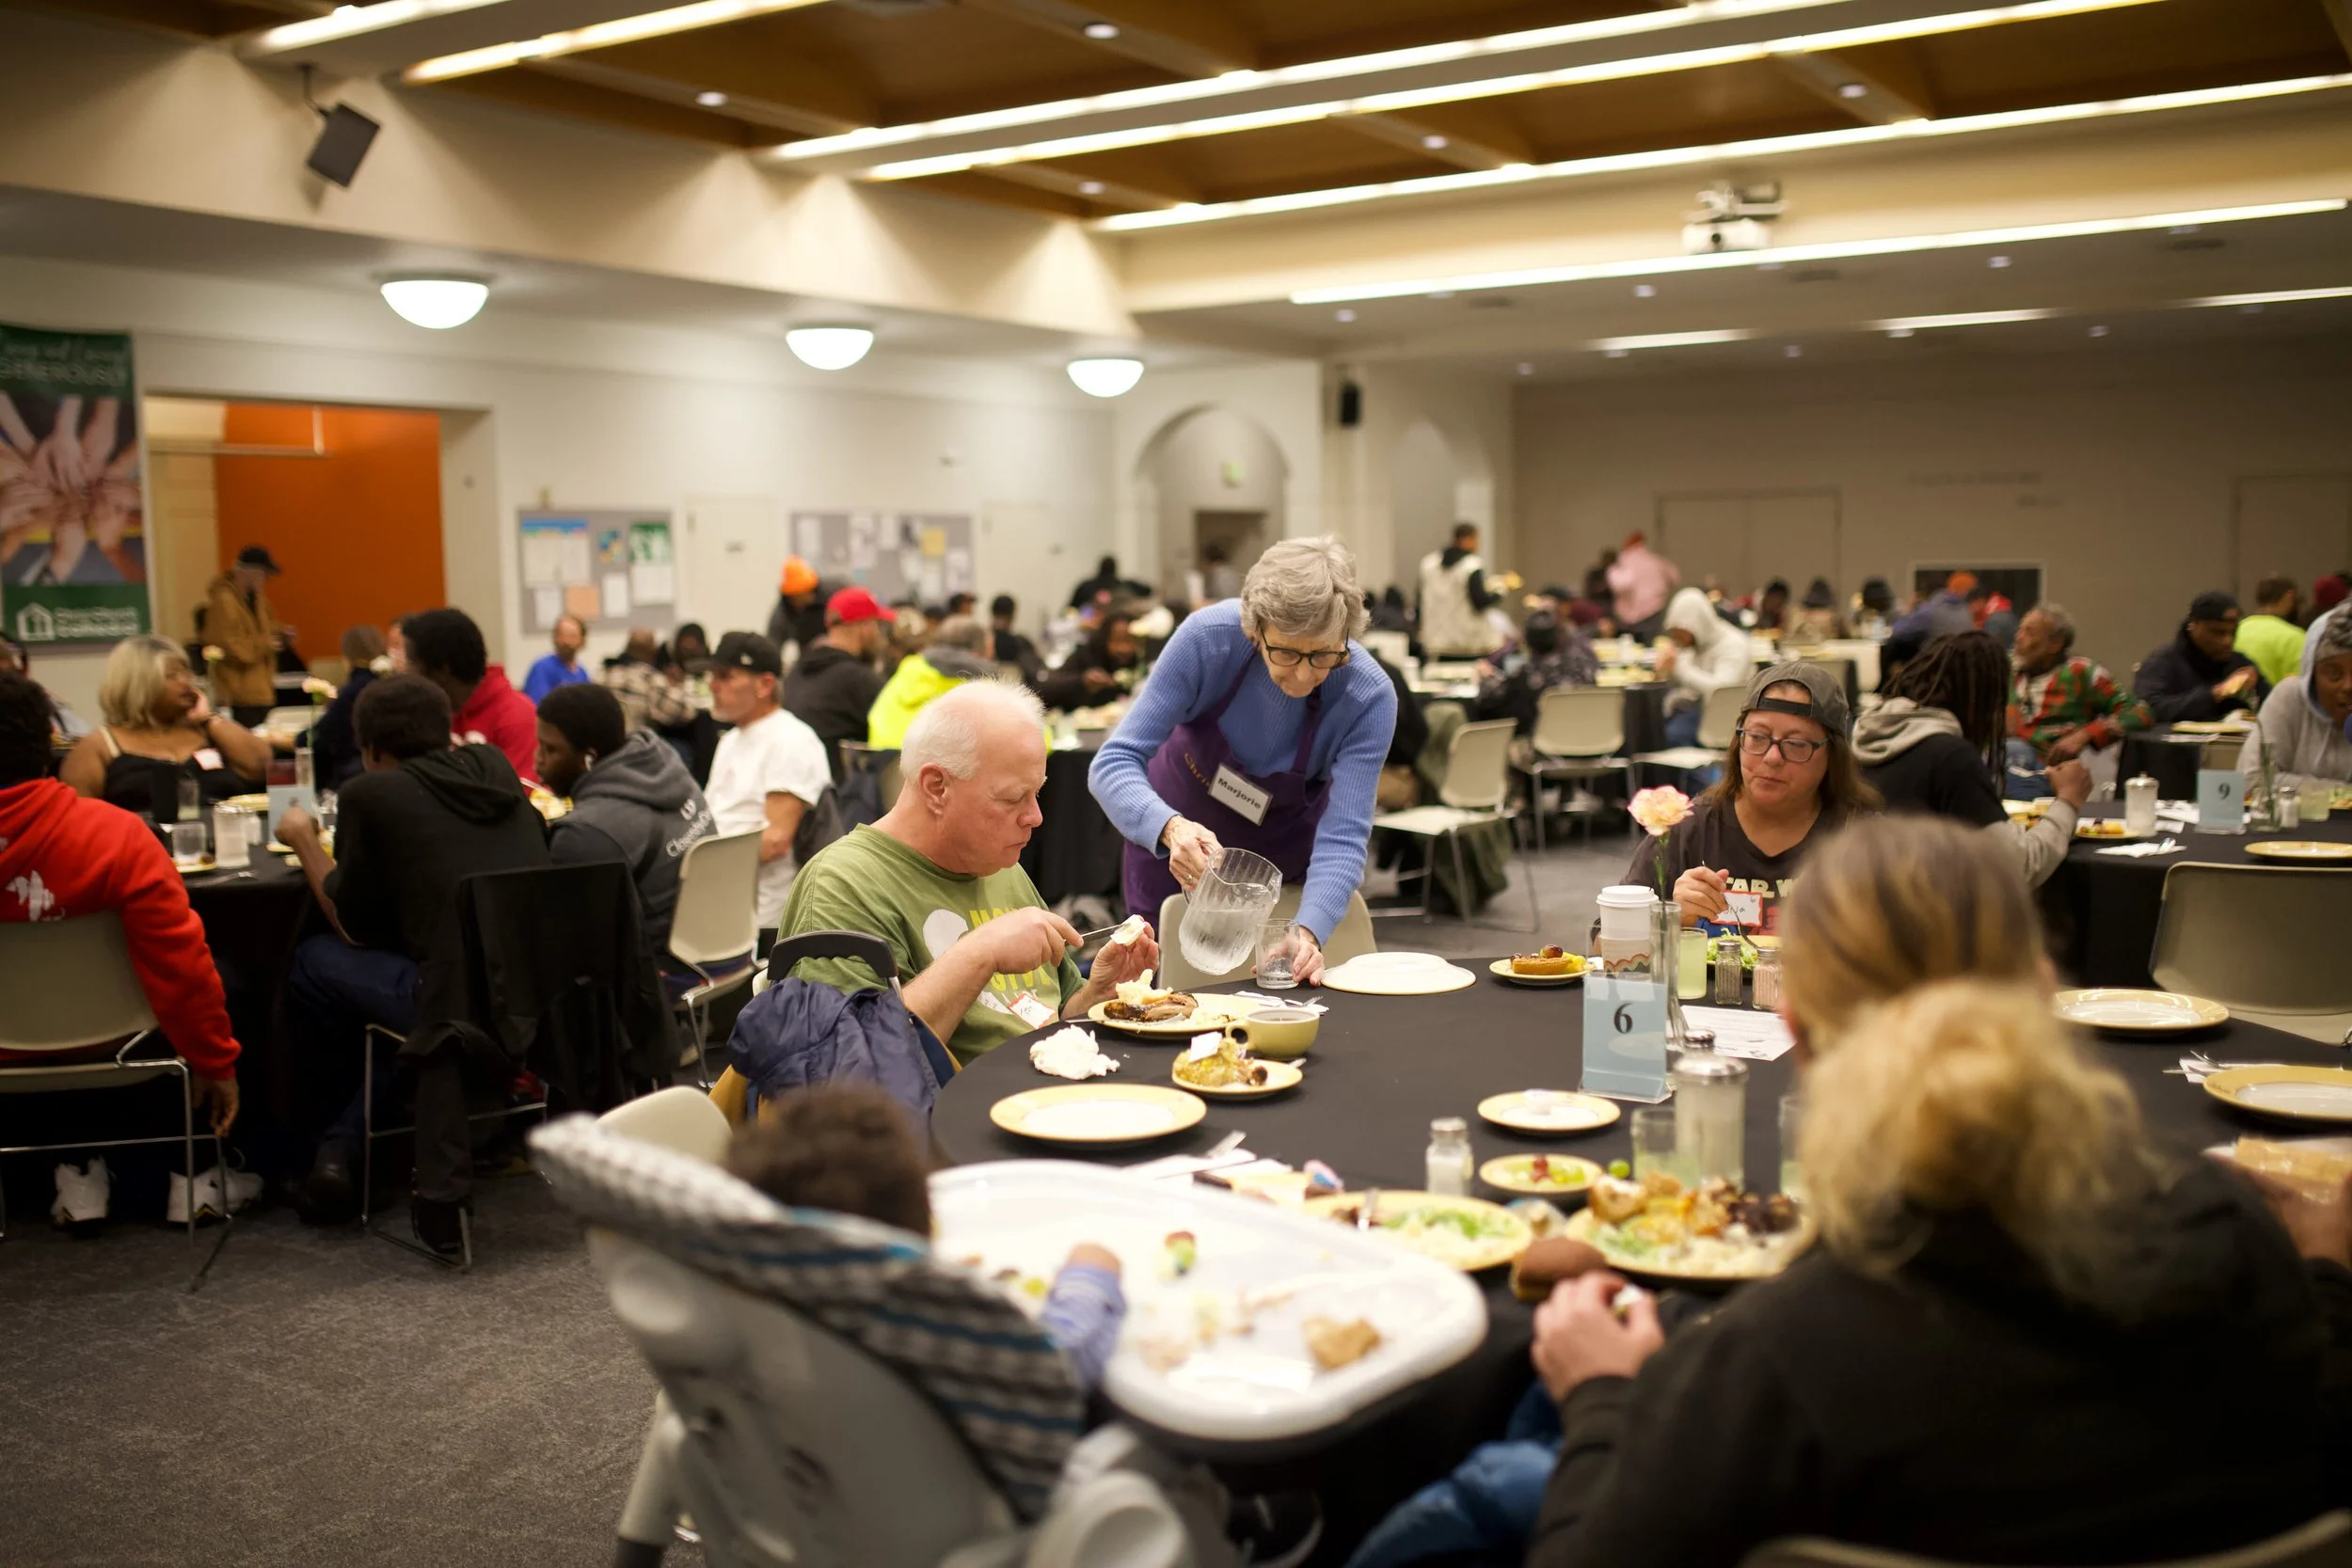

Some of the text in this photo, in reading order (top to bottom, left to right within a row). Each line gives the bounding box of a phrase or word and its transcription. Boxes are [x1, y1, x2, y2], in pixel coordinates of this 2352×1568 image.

[1217, 777, 1262, 810] Marjorie
[2217, 782, 2232, 800] 9
[1613, 1003, 1633, 1034] 6
